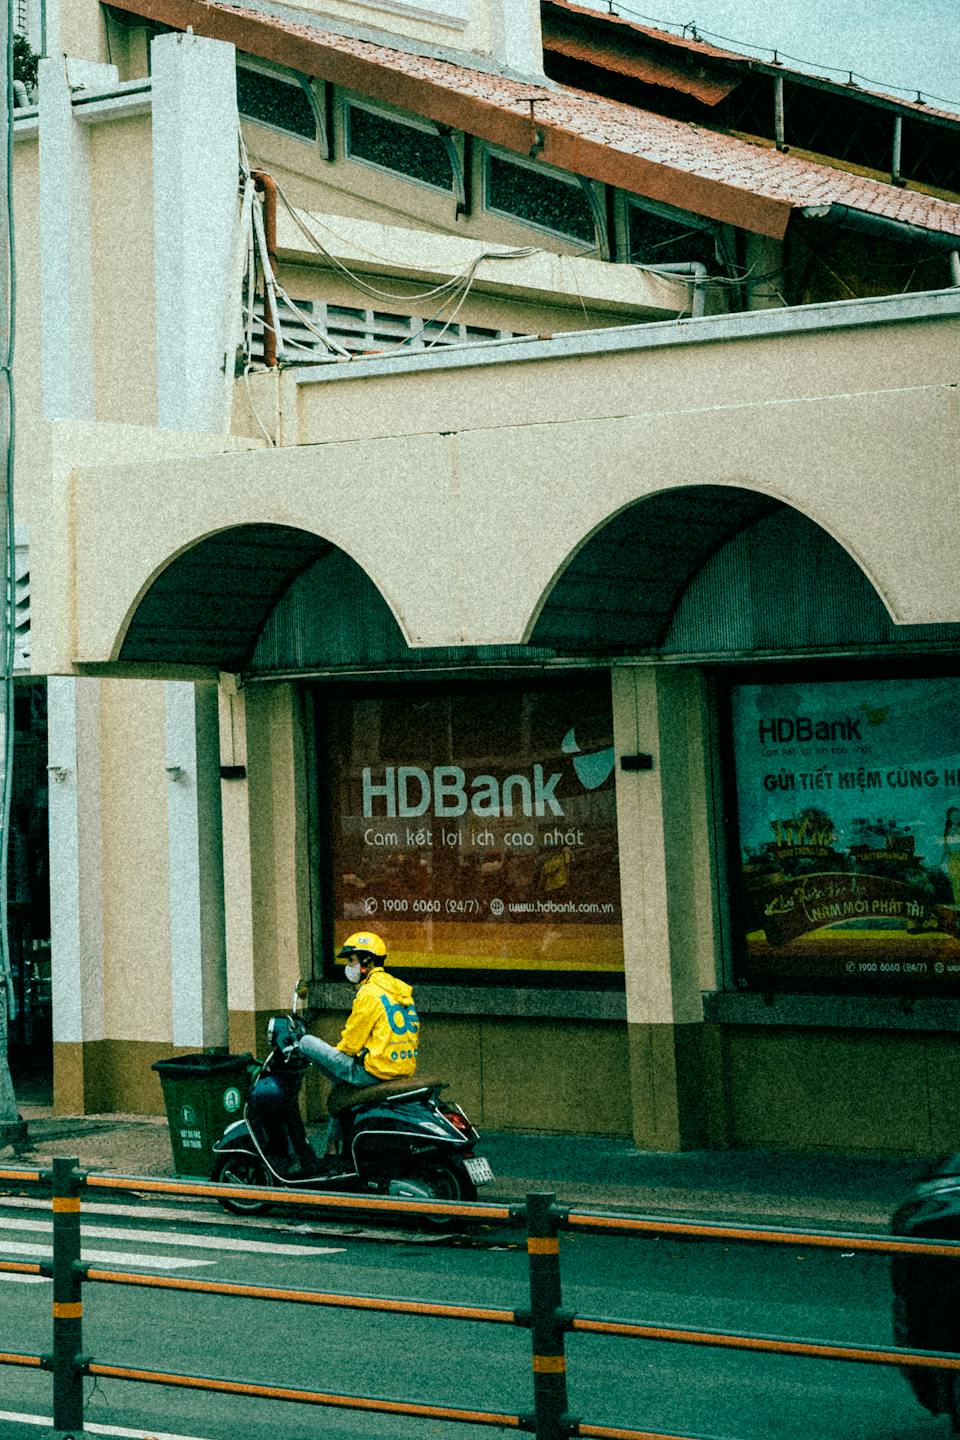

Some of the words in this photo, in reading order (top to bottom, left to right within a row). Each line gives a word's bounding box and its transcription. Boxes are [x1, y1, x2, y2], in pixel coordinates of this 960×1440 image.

[758, 716, 863, 744] HDBank
[361, 764, 565, 818] HDBank
[800, 764, 834, 791] TIẾT
[838, 767, 884, 793] KIỆM
[887, 767, 939, 788] CÙNG
[364, 829, 398, 846] Cam
[406, 828, 433, 846] kết
[442, 828, 462, 849] lợi
[471, 828, 495, 846] ích
[503, 833, 534, 846] cao
[544, 828, 584, 846] nhất
[382, 899, 408, 911] 1900
[412, 899, 441, 911] 6060
[444, 899, 480, 914] (24/7)
[508, 900, 614, 914] www.hdbank.com.vn
[858, 963, 877, 972] 1900
[380, 994, 419, 1035] be
